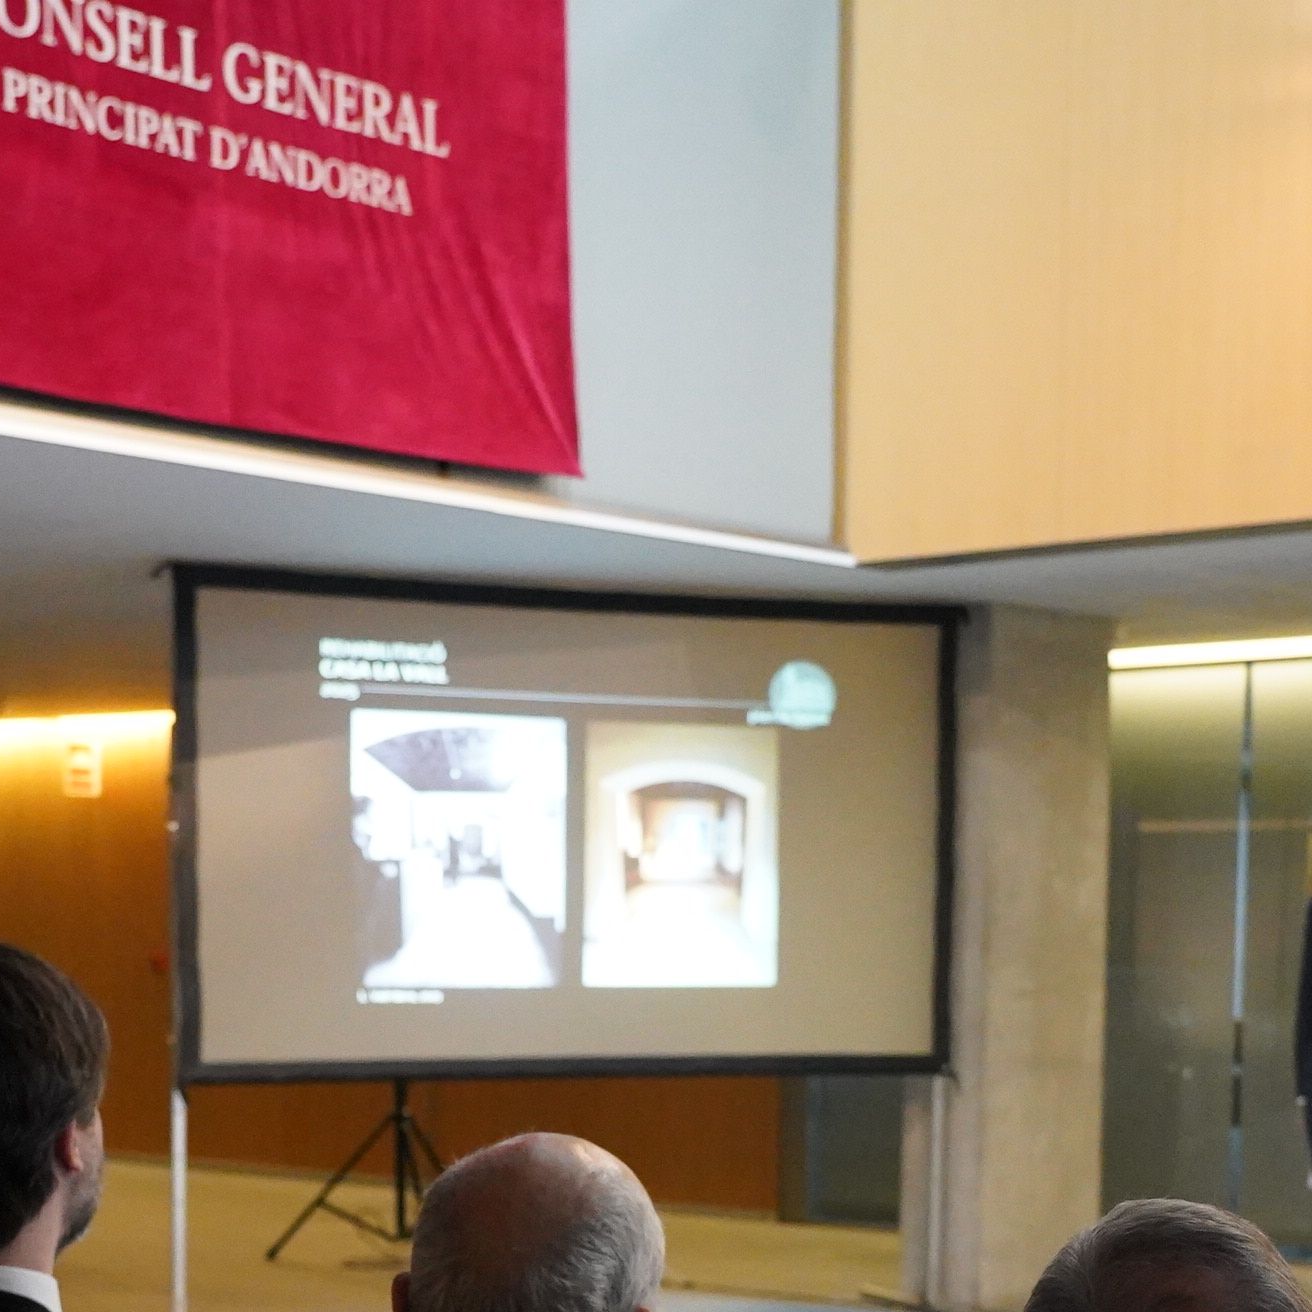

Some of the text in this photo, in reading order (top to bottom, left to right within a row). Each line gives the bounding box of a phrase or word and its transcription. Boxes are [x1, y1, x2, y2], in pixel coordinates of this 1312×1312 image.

[1, 66, 414, 217] PRINCIPAT D'ANDORRA
[221, 41, 451, 159] GENERAL
